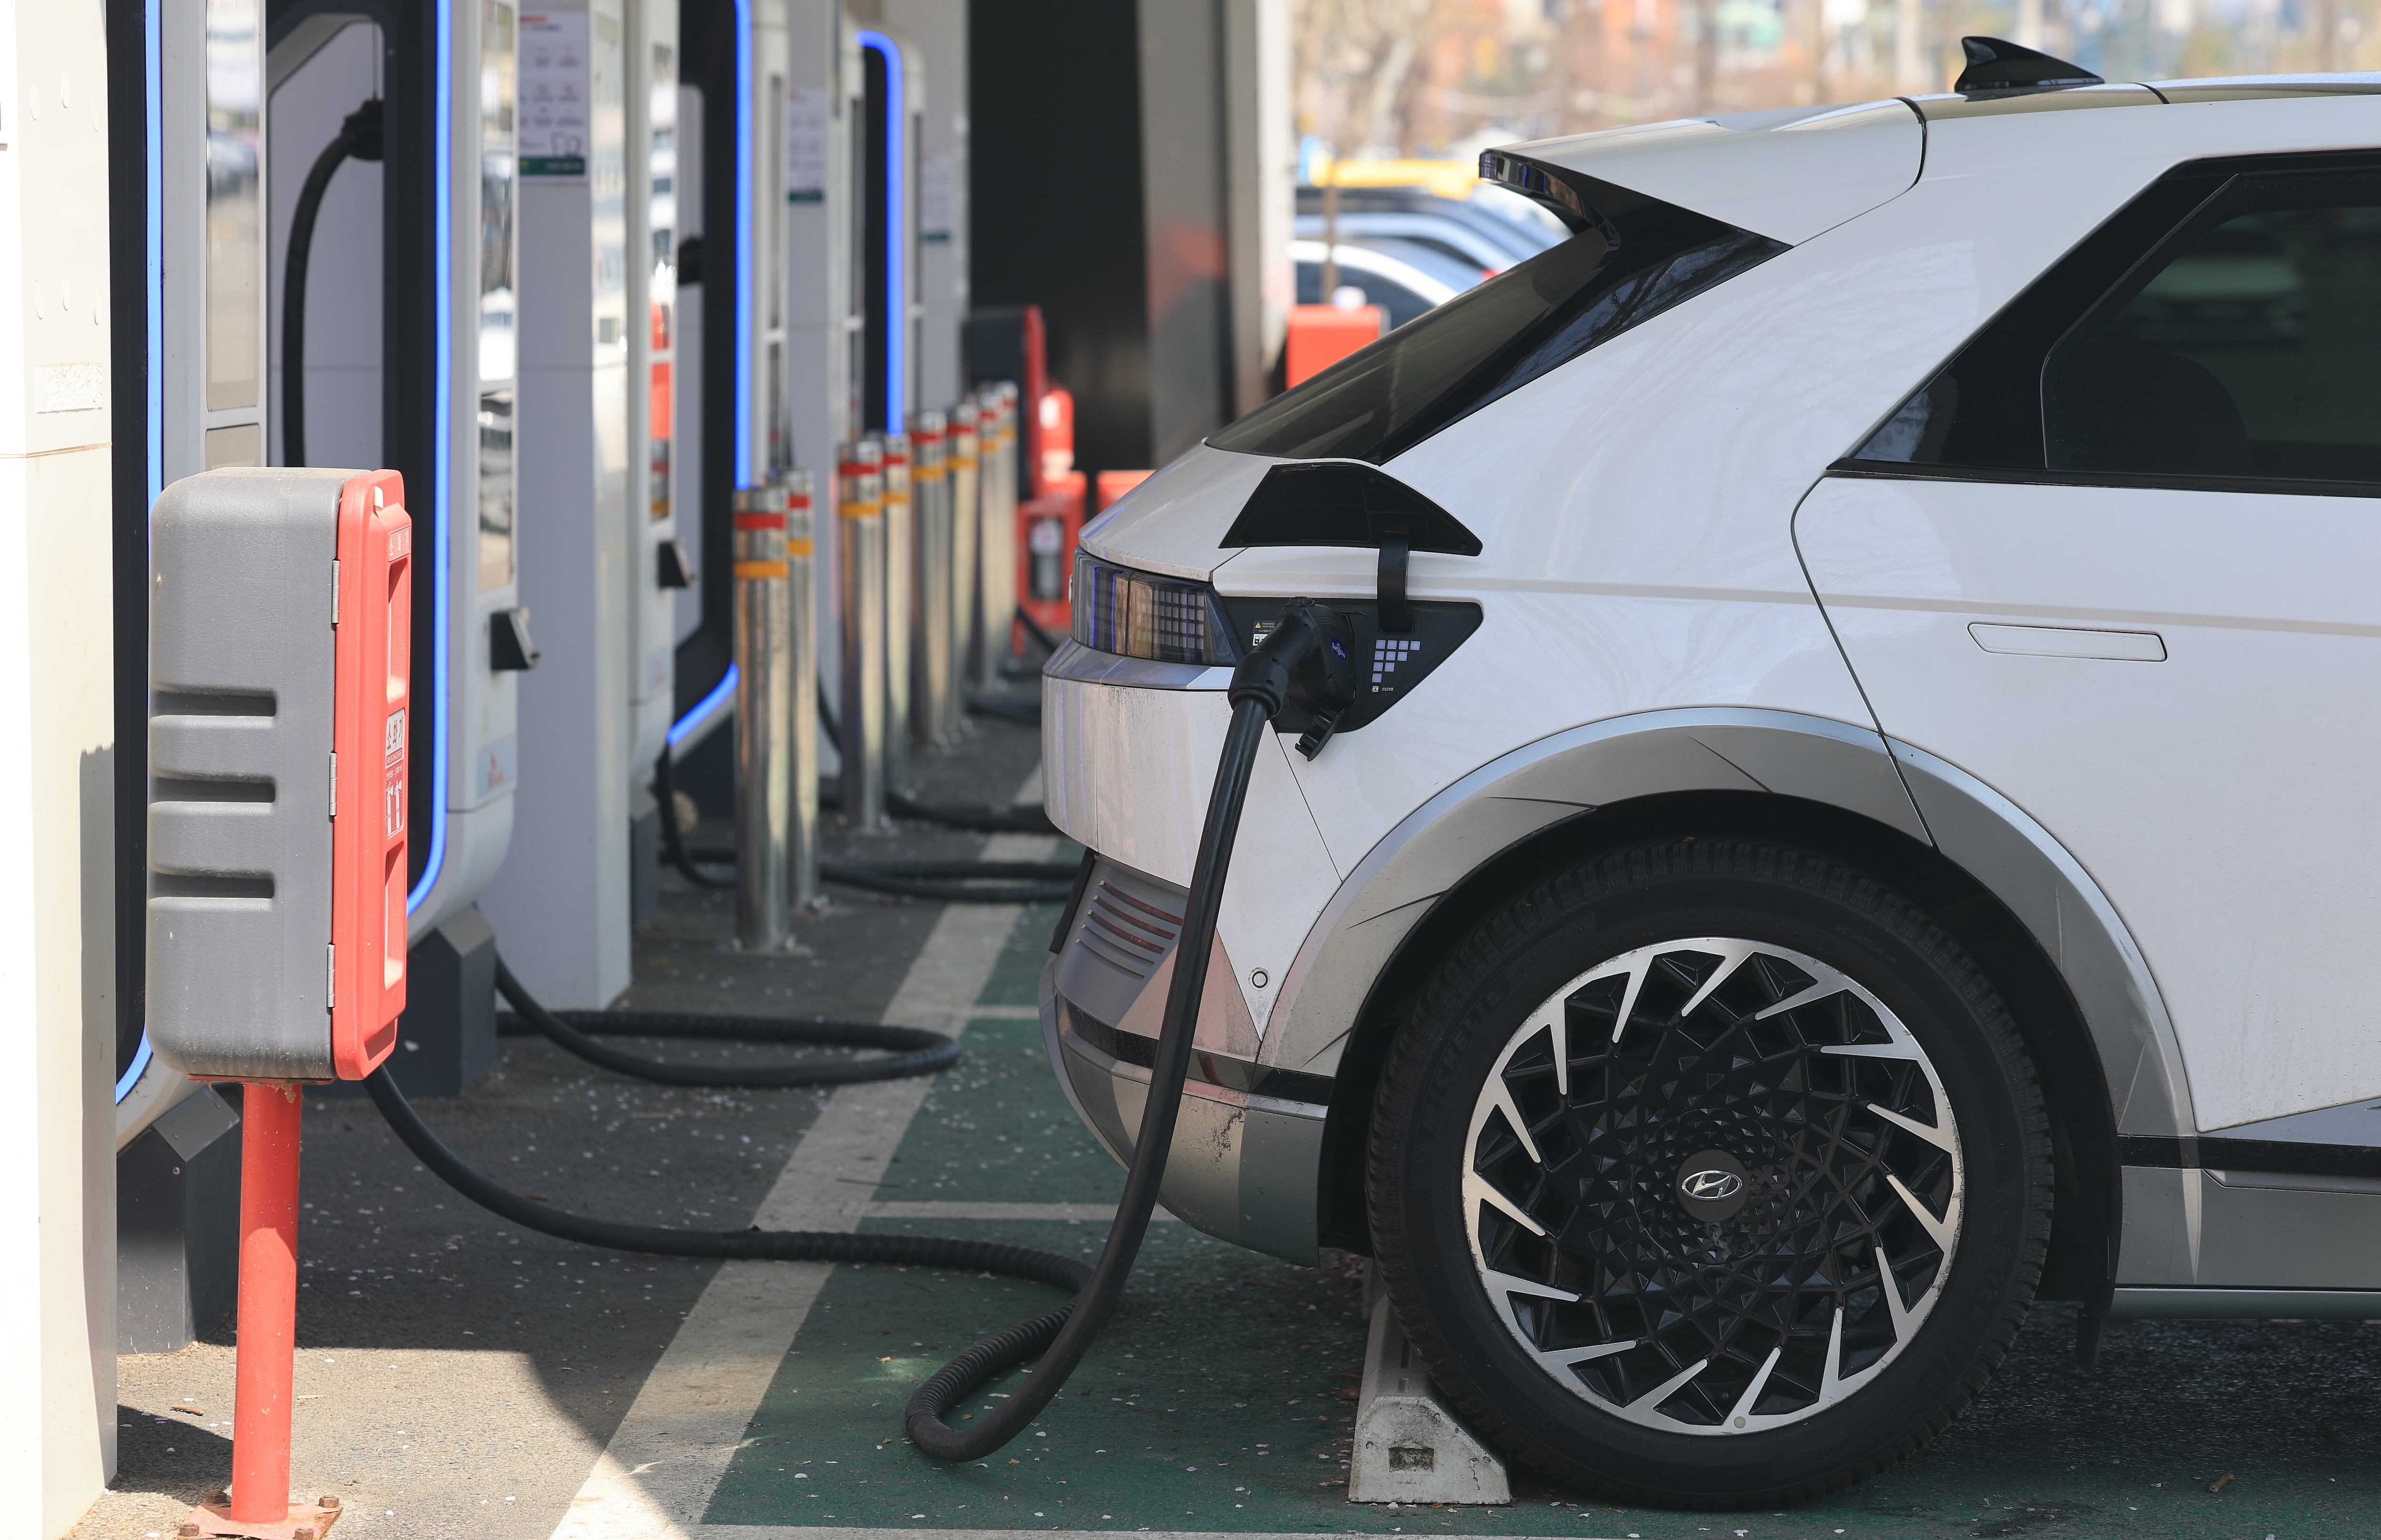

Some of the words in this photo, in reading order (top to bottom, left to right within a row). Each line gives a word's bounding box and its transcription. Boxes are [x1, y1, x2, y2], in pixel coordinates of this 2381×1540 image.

[390, 530, 409, 556] 소화기
[387, 716, 403, 750] 소화기
[1517, 940, 1558, 976] 255/45
[1557, 933, 1569, 945] R
[1569, 924, 1586, 939] 20
[1835, 922, 1885, 956] ROTATION
[1422, 983, 1505, 1132] MICHELIN
[1921, 1245, 2006, 1392] MICHELIN
